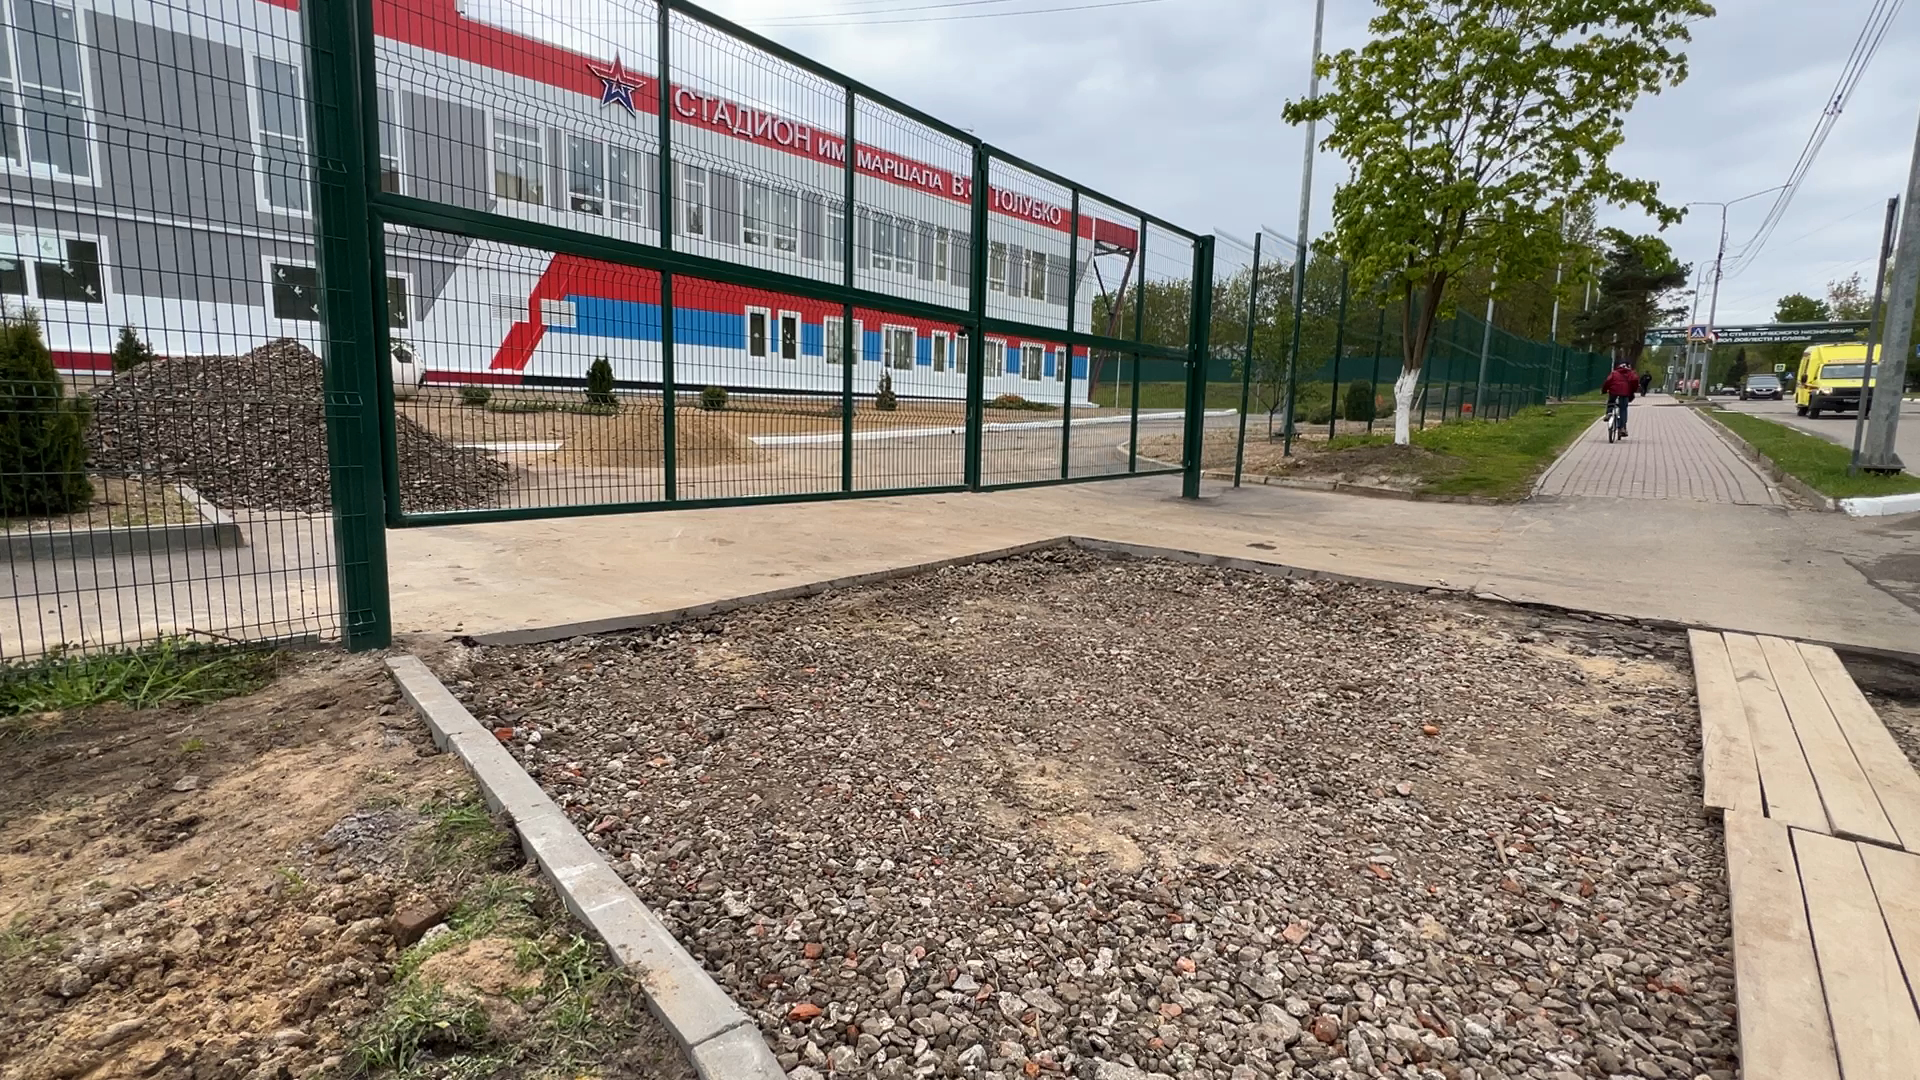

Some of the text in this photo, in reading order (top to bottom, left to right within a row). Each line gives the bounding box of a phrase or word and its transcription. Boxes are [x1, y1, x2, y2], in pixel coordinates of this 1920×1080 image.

[673, 88, 811, 152] СТАДИОН
[856, 149, 944, 191] МАРШАЛА
[991, 185, 1062, 226] ТОЛУБКО
